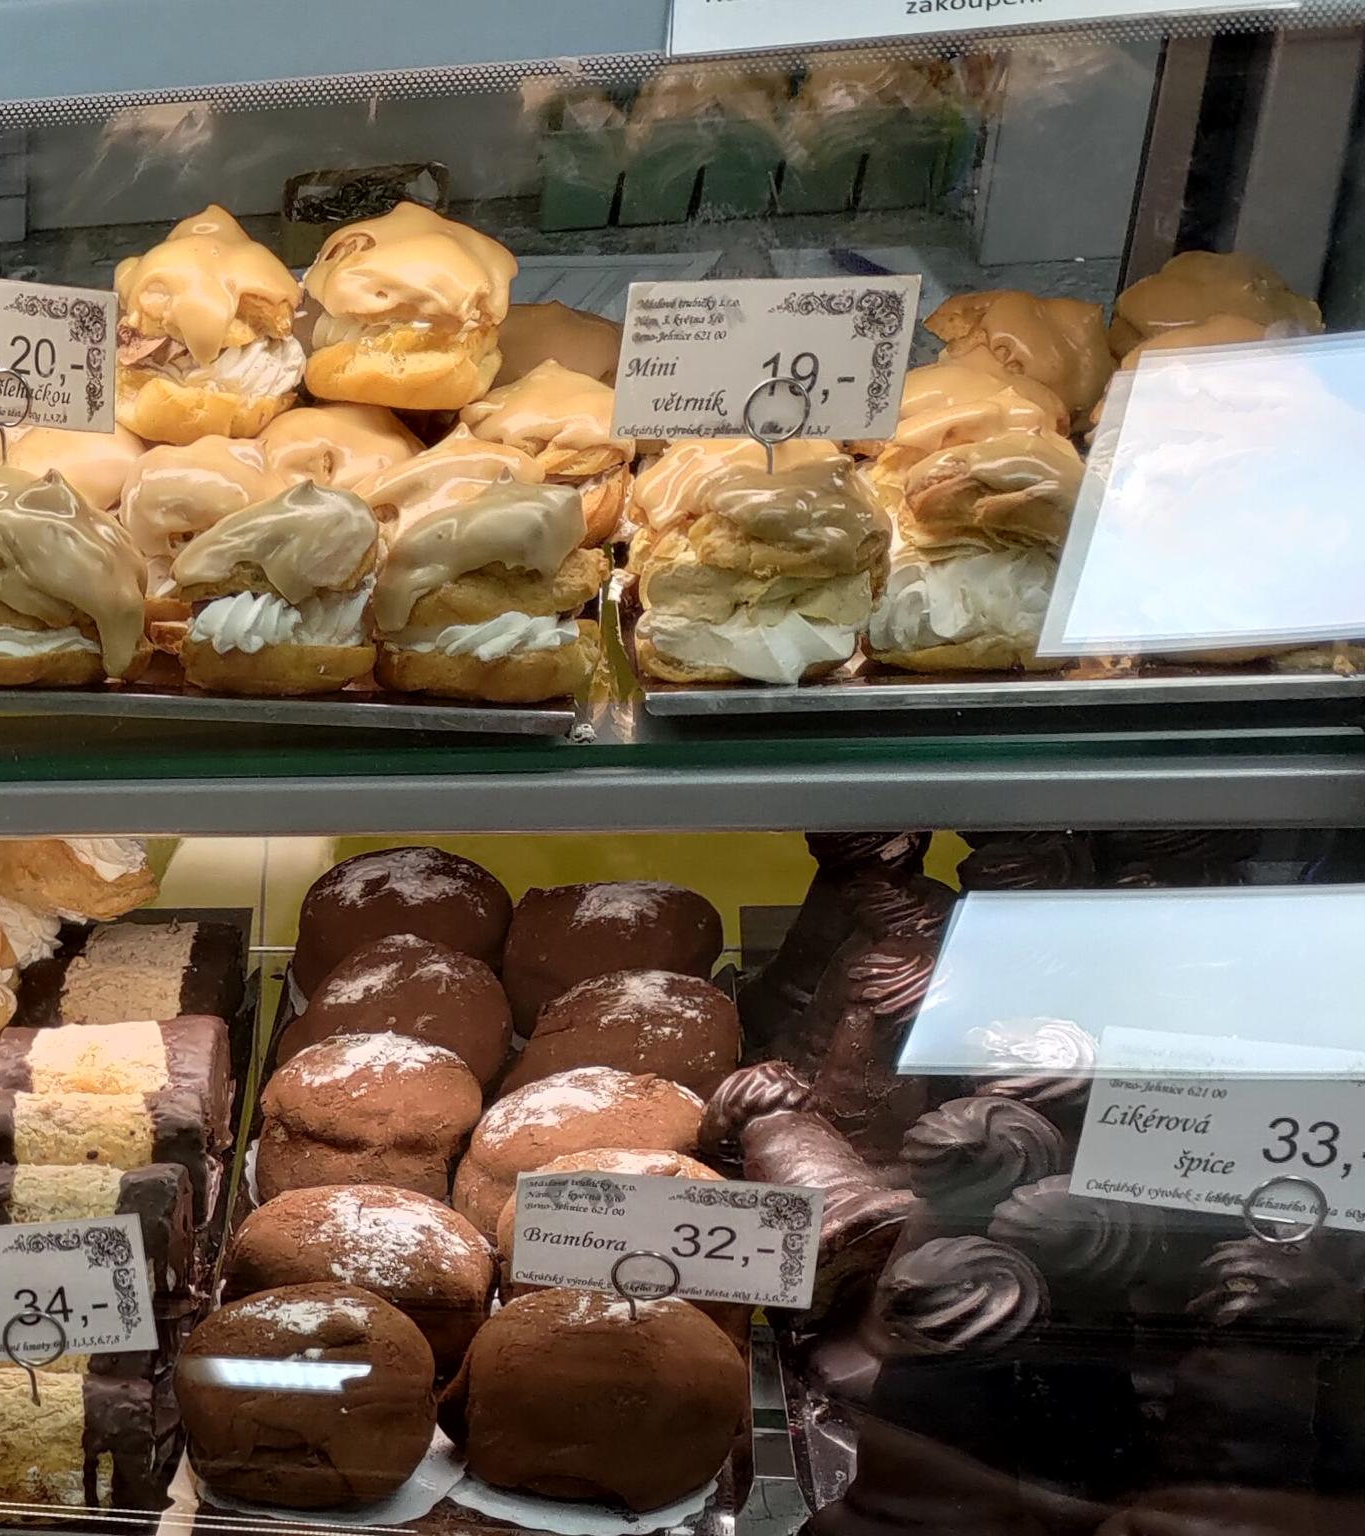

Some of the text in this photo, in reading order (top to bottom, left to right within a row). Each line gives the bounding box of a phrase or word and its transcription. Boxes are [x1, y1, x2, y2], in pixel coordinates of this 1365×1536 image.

[10, 335, 84, 386] 20,-
[625, 357, 679, 378] Mini
[652, 390, 728, 416] větrník
[1187, 1086, 1208, 1098] 621
[1211, 1089, 1227, 1099] 00
[1098, 1105, 1213, 1134] Likérová
[1174, 1150, 1236, 1178] špice
[523, 1223, 775, 1267] Brambora 32,-
[14, 1286, 109, 1328] 34,-
